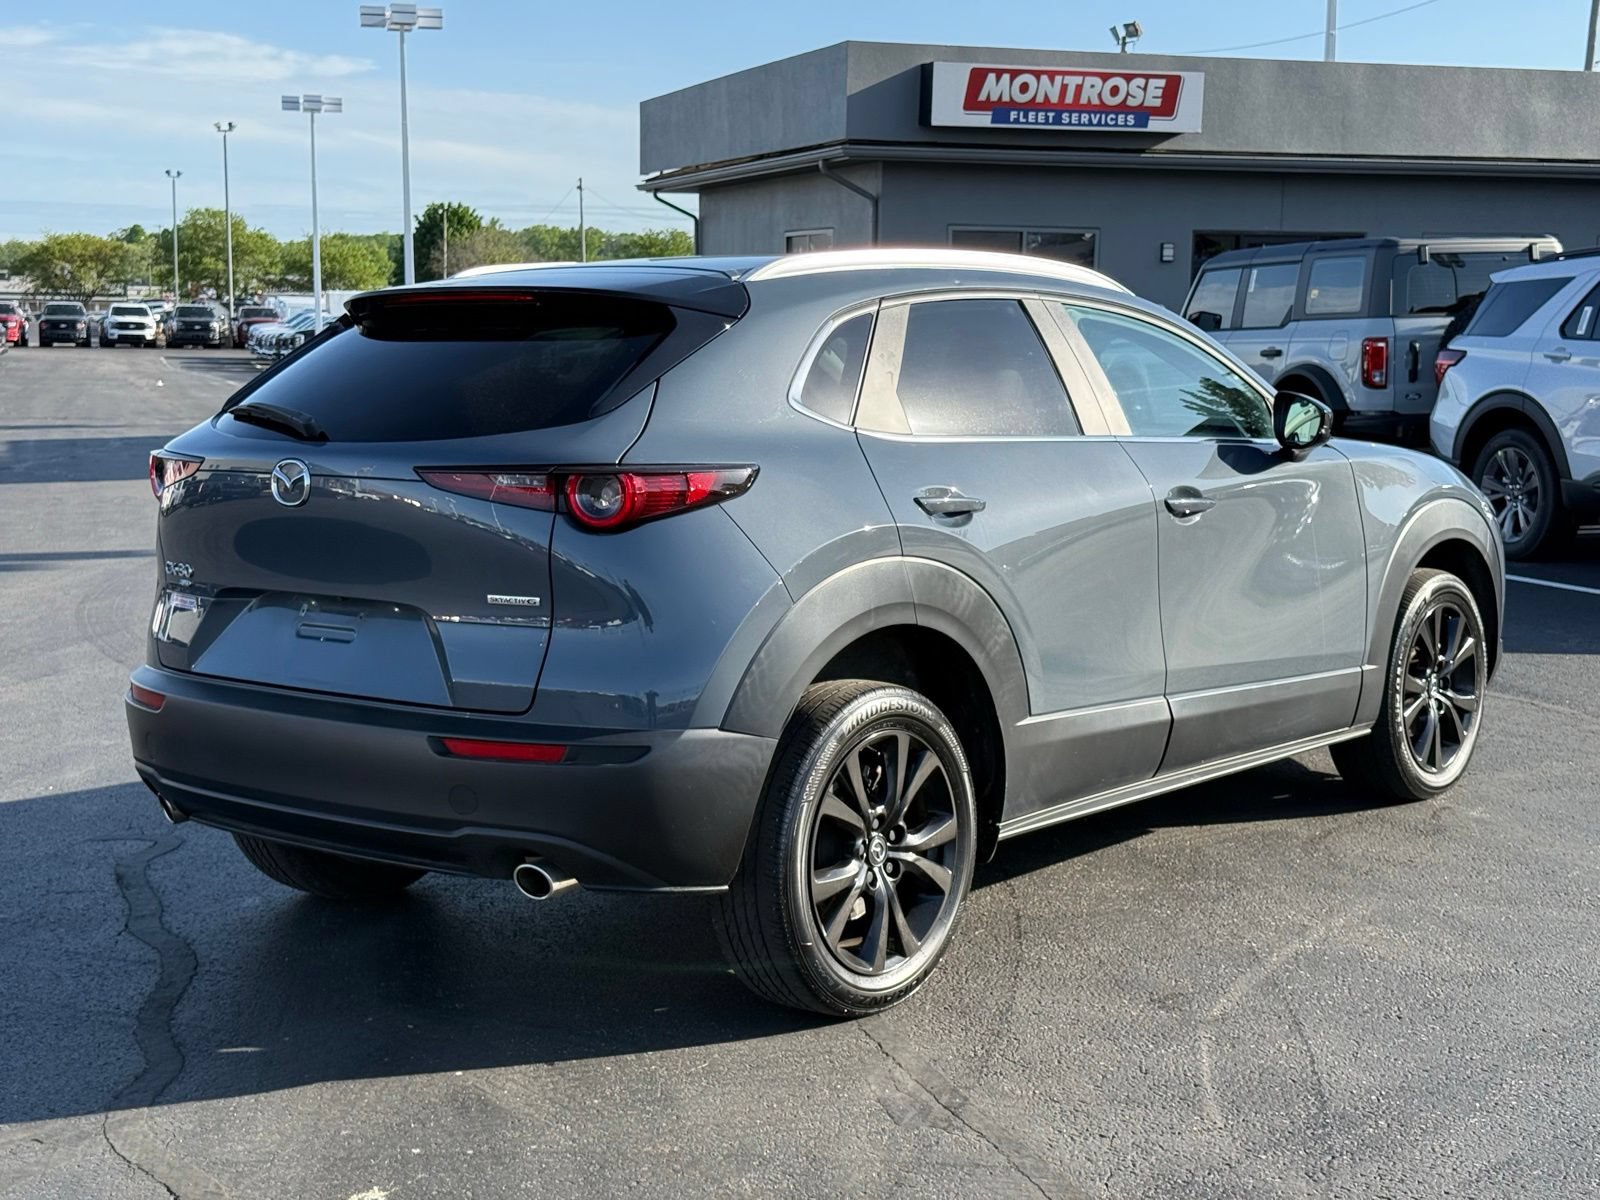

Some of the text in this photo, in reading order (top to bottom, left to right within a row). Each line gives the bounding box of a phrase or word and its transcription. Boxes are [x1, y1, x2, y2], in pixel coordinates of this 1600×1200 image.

[977, 72, 1166, 107] MONTROSE
[1009, 111, 1136, 126] FLEET SERVICES
